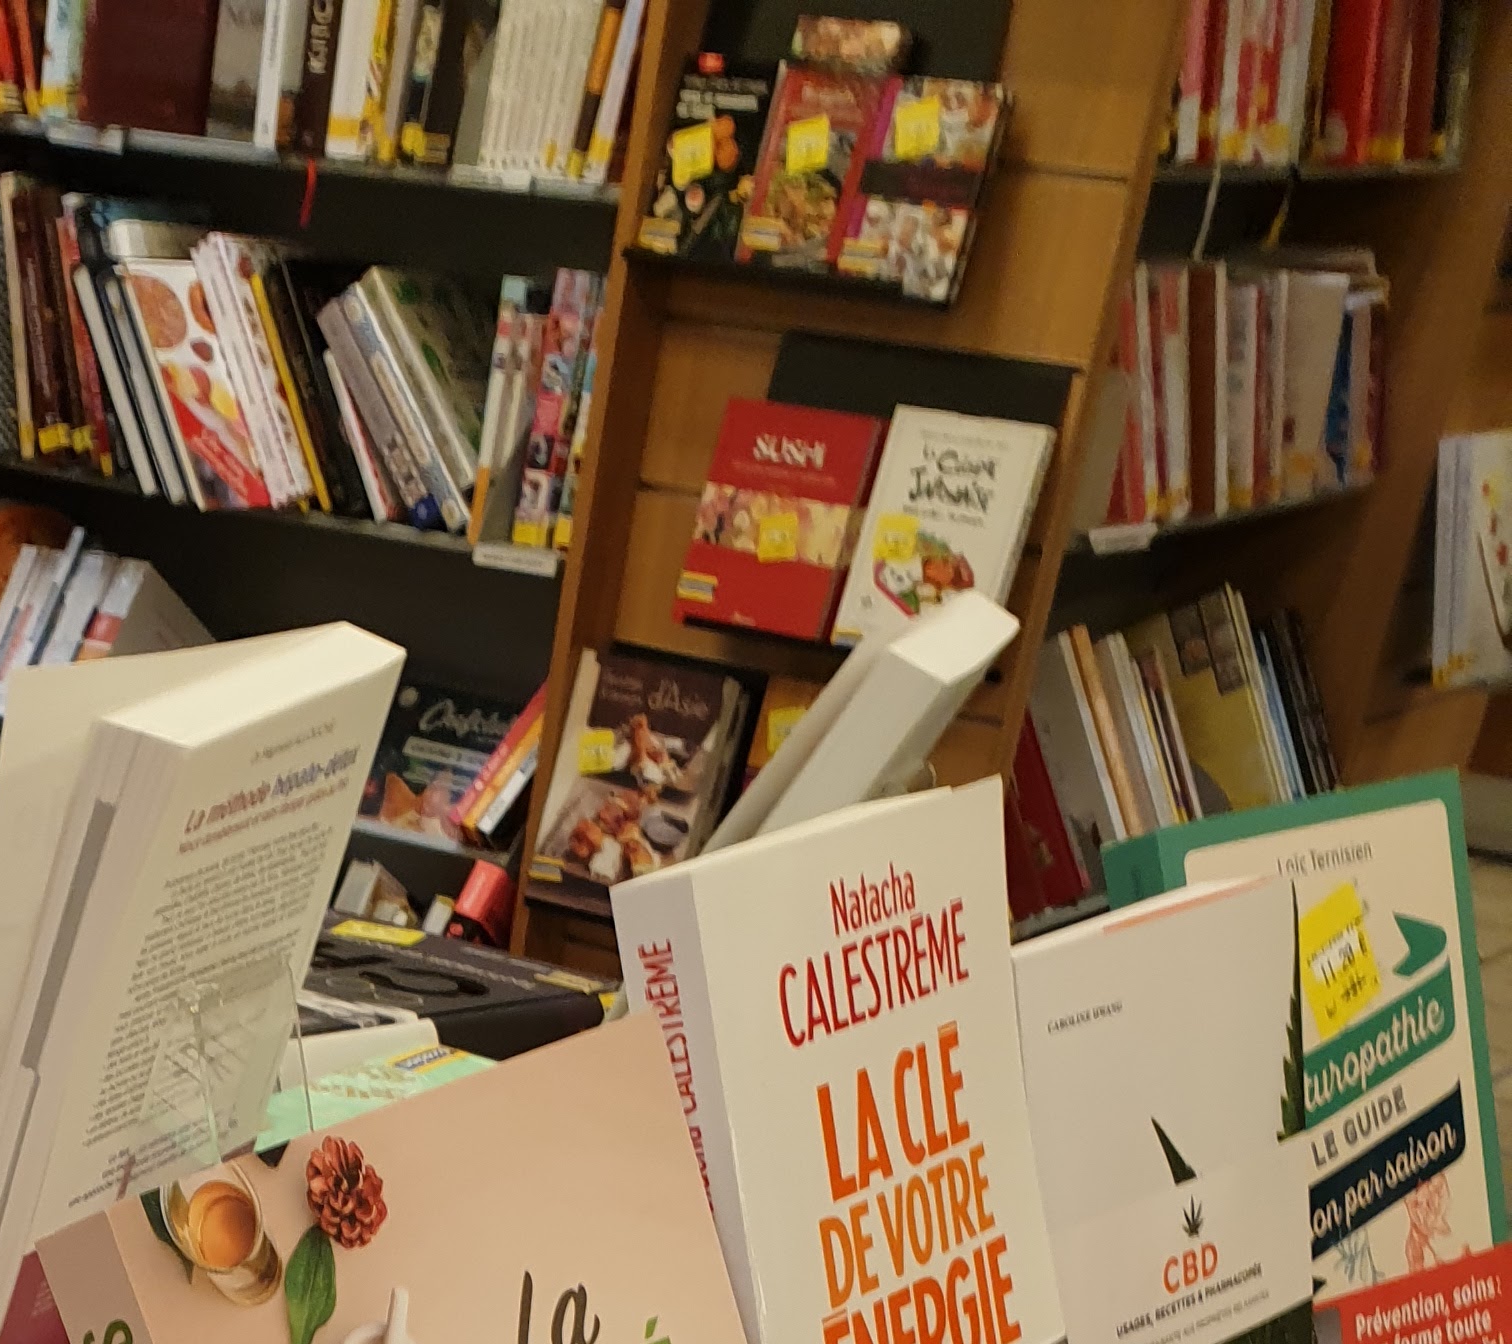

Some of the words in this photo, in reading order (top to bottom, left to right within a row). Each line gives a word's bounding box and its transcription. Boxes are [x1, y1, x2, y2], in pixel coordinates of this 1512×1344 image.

[828, 862, 916, 937] Natacha
[815, 1067, 894, 1202] LA
[1342, 1082, 1408, 1146] GUIDE
[1383, 1118, 1459, 1186] saison
[818, 1202, 881, 1310] DE
[875, 1142, 997, 1279] VOTRE
[1163, 1242, 1219, 1294] CBD
[1354, 1290, 1451, 1342] Prévention,
[1444, 1307, 1493, 1344] toute
